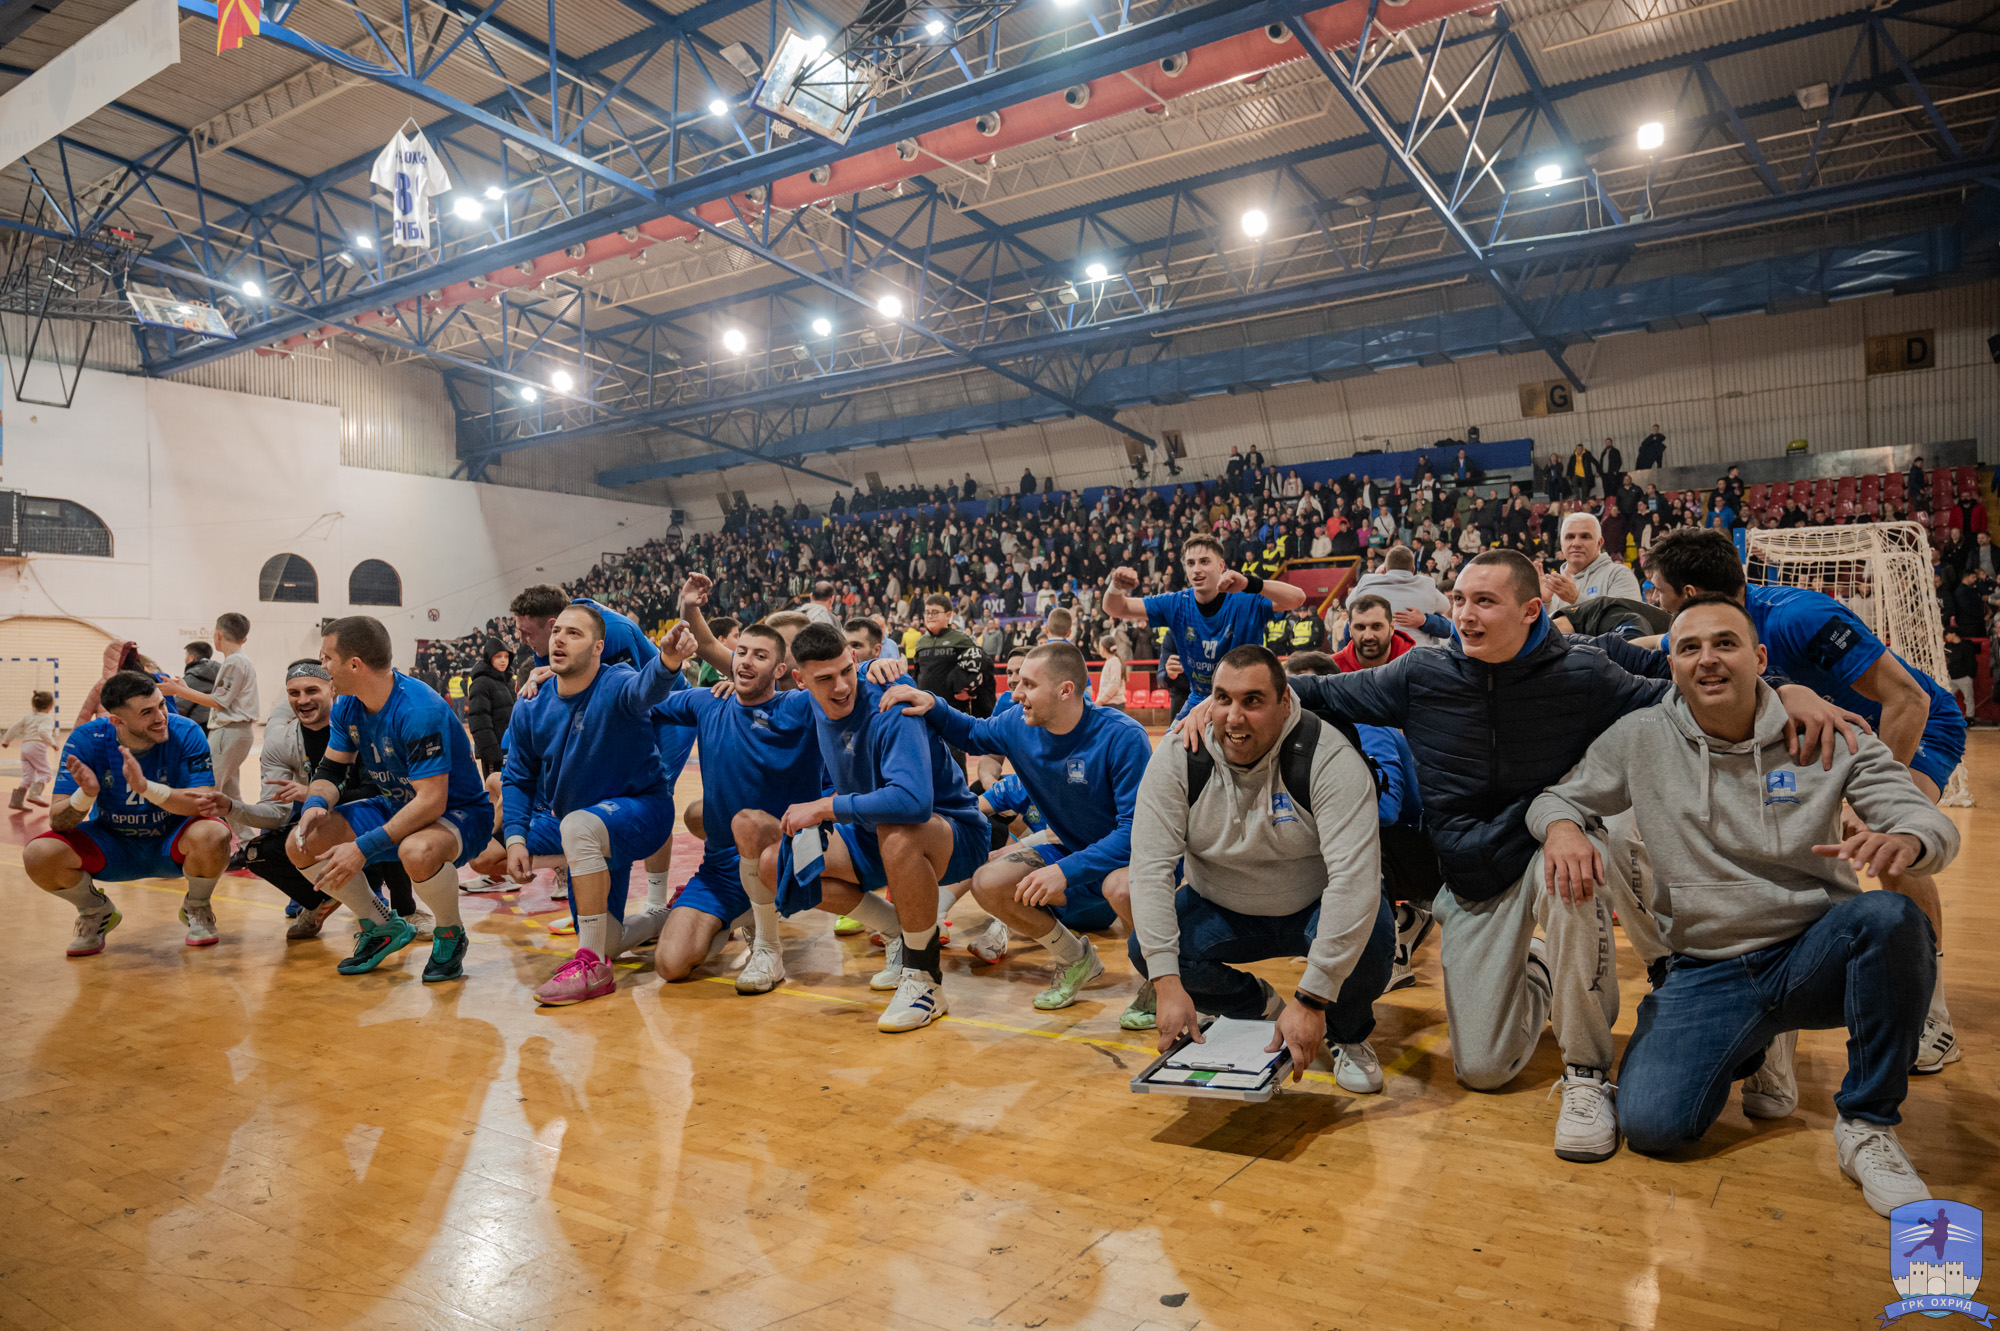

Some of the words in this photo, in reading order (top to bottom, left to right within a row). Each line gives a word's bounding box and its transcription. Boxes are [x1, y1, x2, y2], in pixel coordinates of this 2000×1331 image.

[1907, 337, 1928, 364] D
[1550, 385, 1568, 408] G
[1202, 640, 1218, 659] 27
